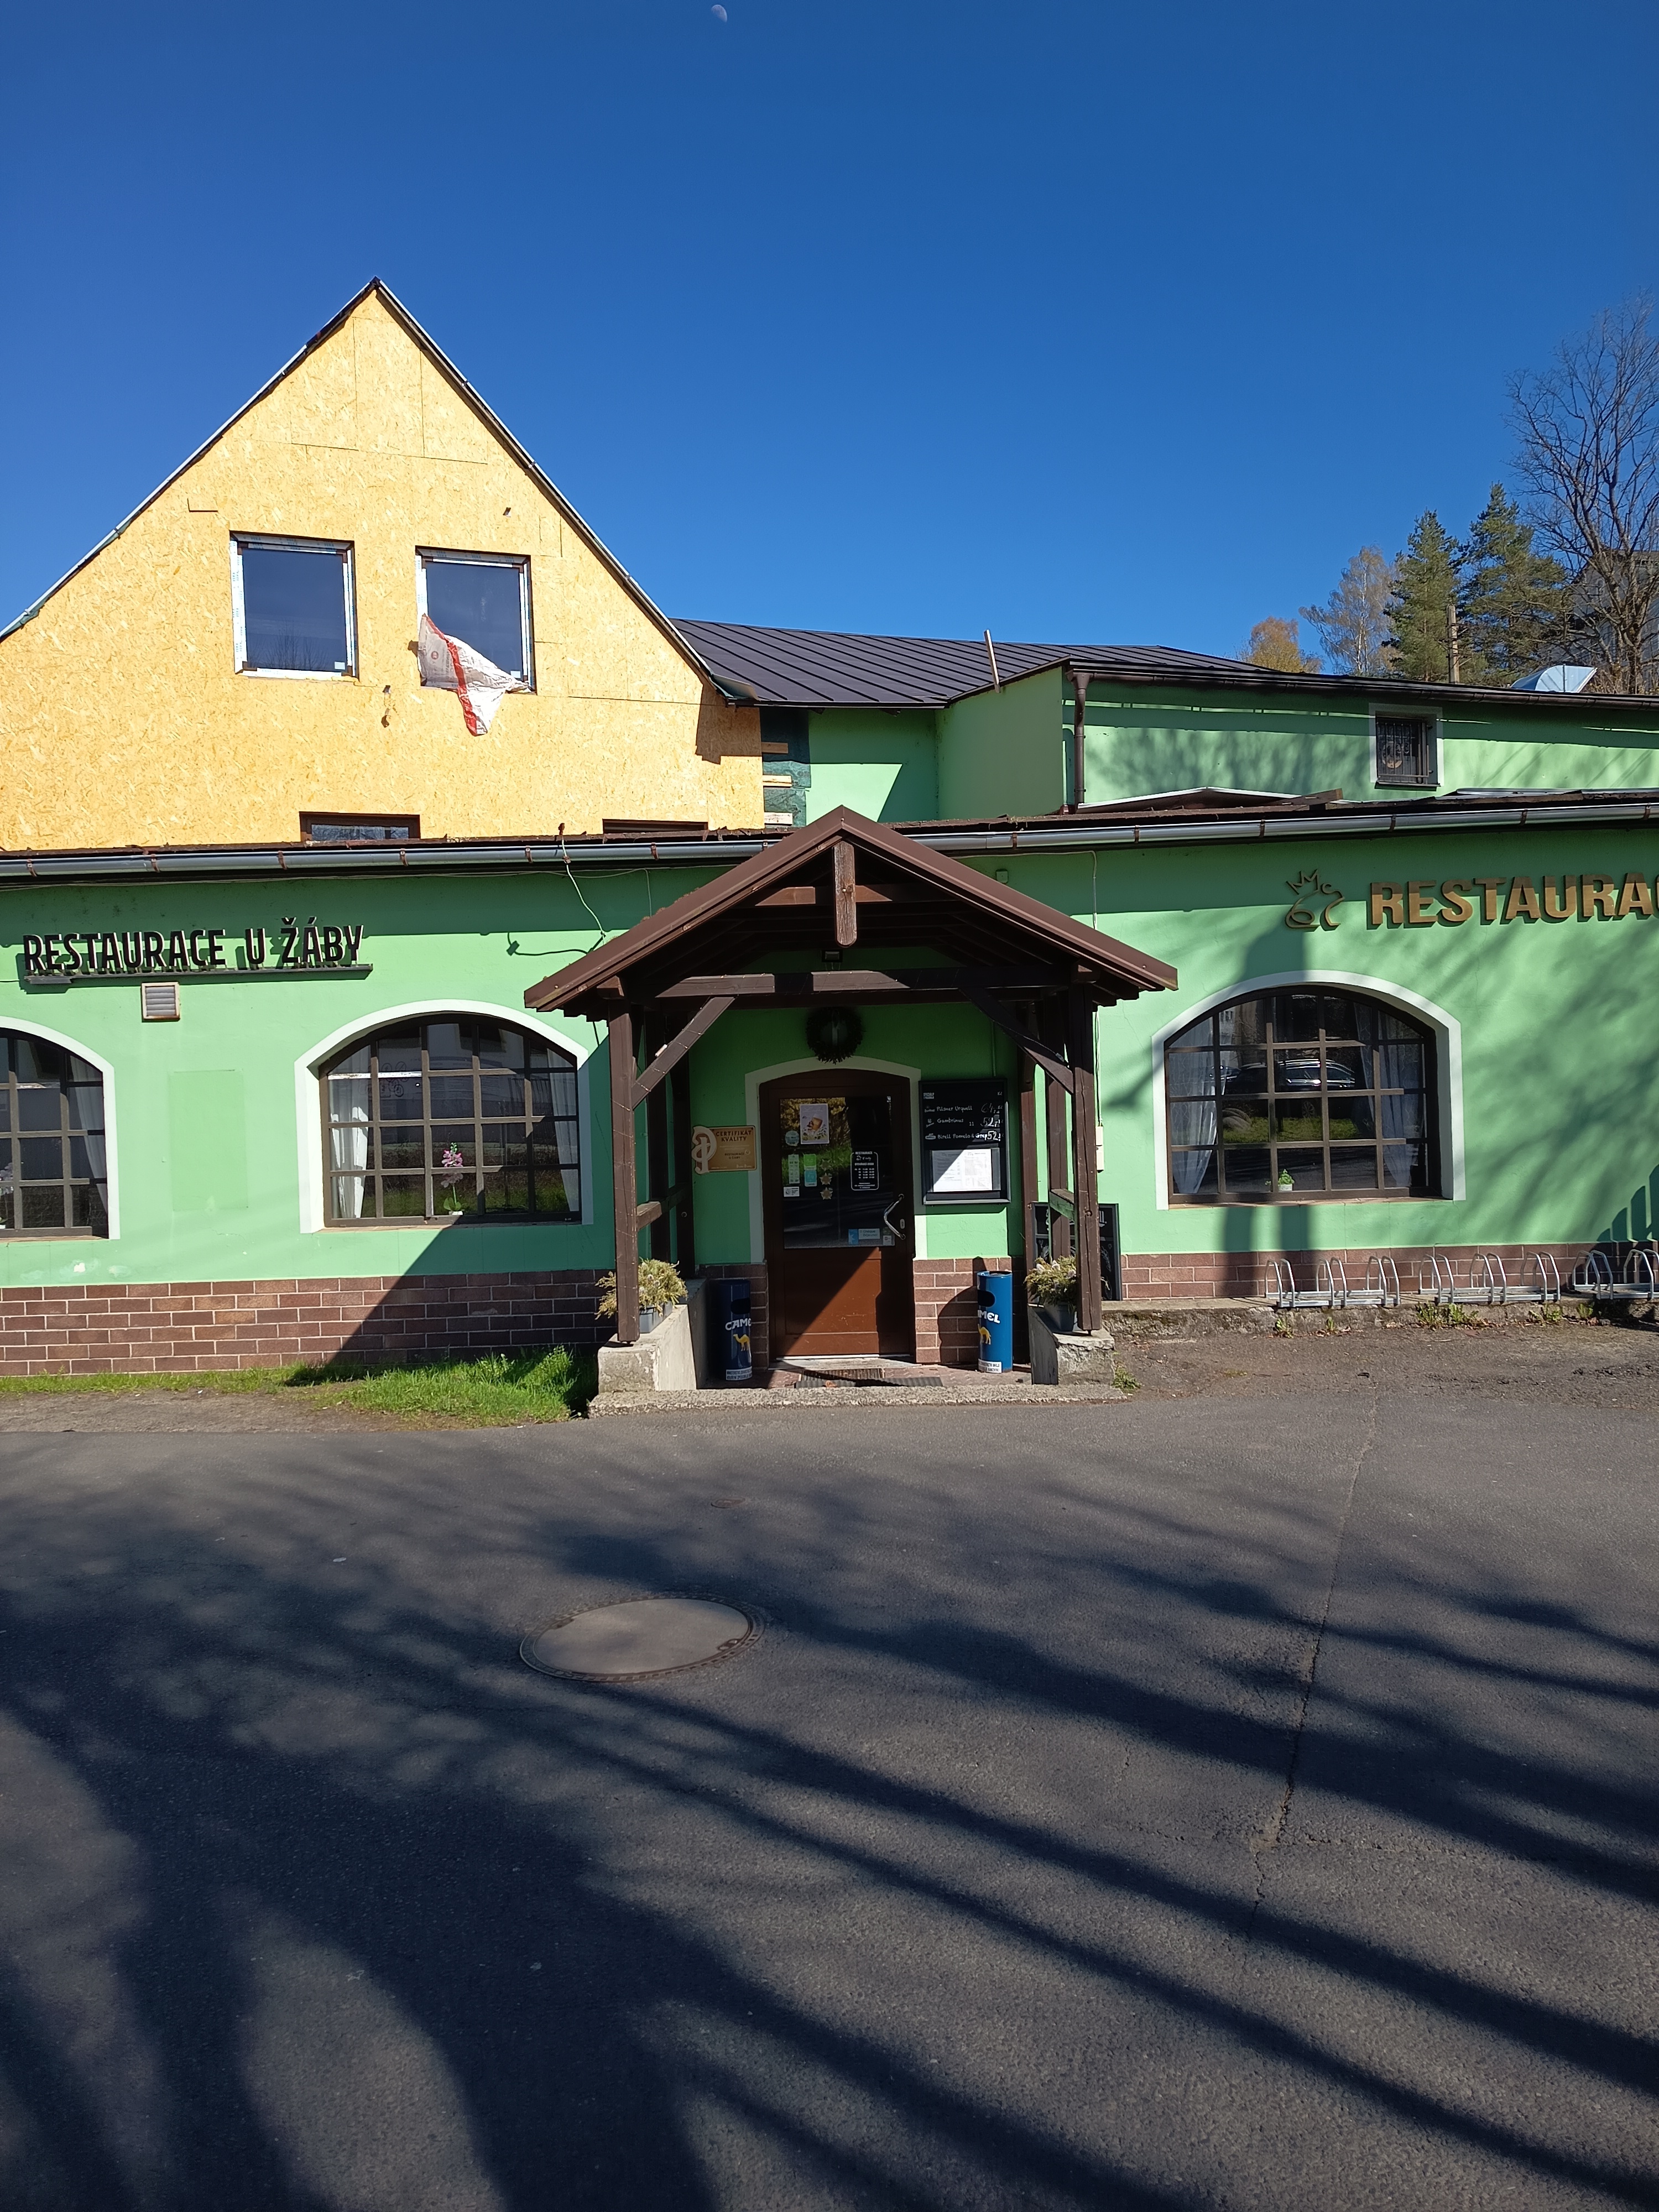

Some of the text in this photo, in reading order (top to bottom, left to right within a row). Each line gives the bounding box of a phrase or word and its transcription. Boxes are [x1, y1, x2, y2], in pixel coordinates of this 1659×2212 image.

[1369, 873, 1659, 925] RESTAURA
[23, 916, 364, 971] RESTAURACE U ŽÁBY
[725, 1318, 752, 1331] CAME
[977, 1310, 1000, 1323] MEL
